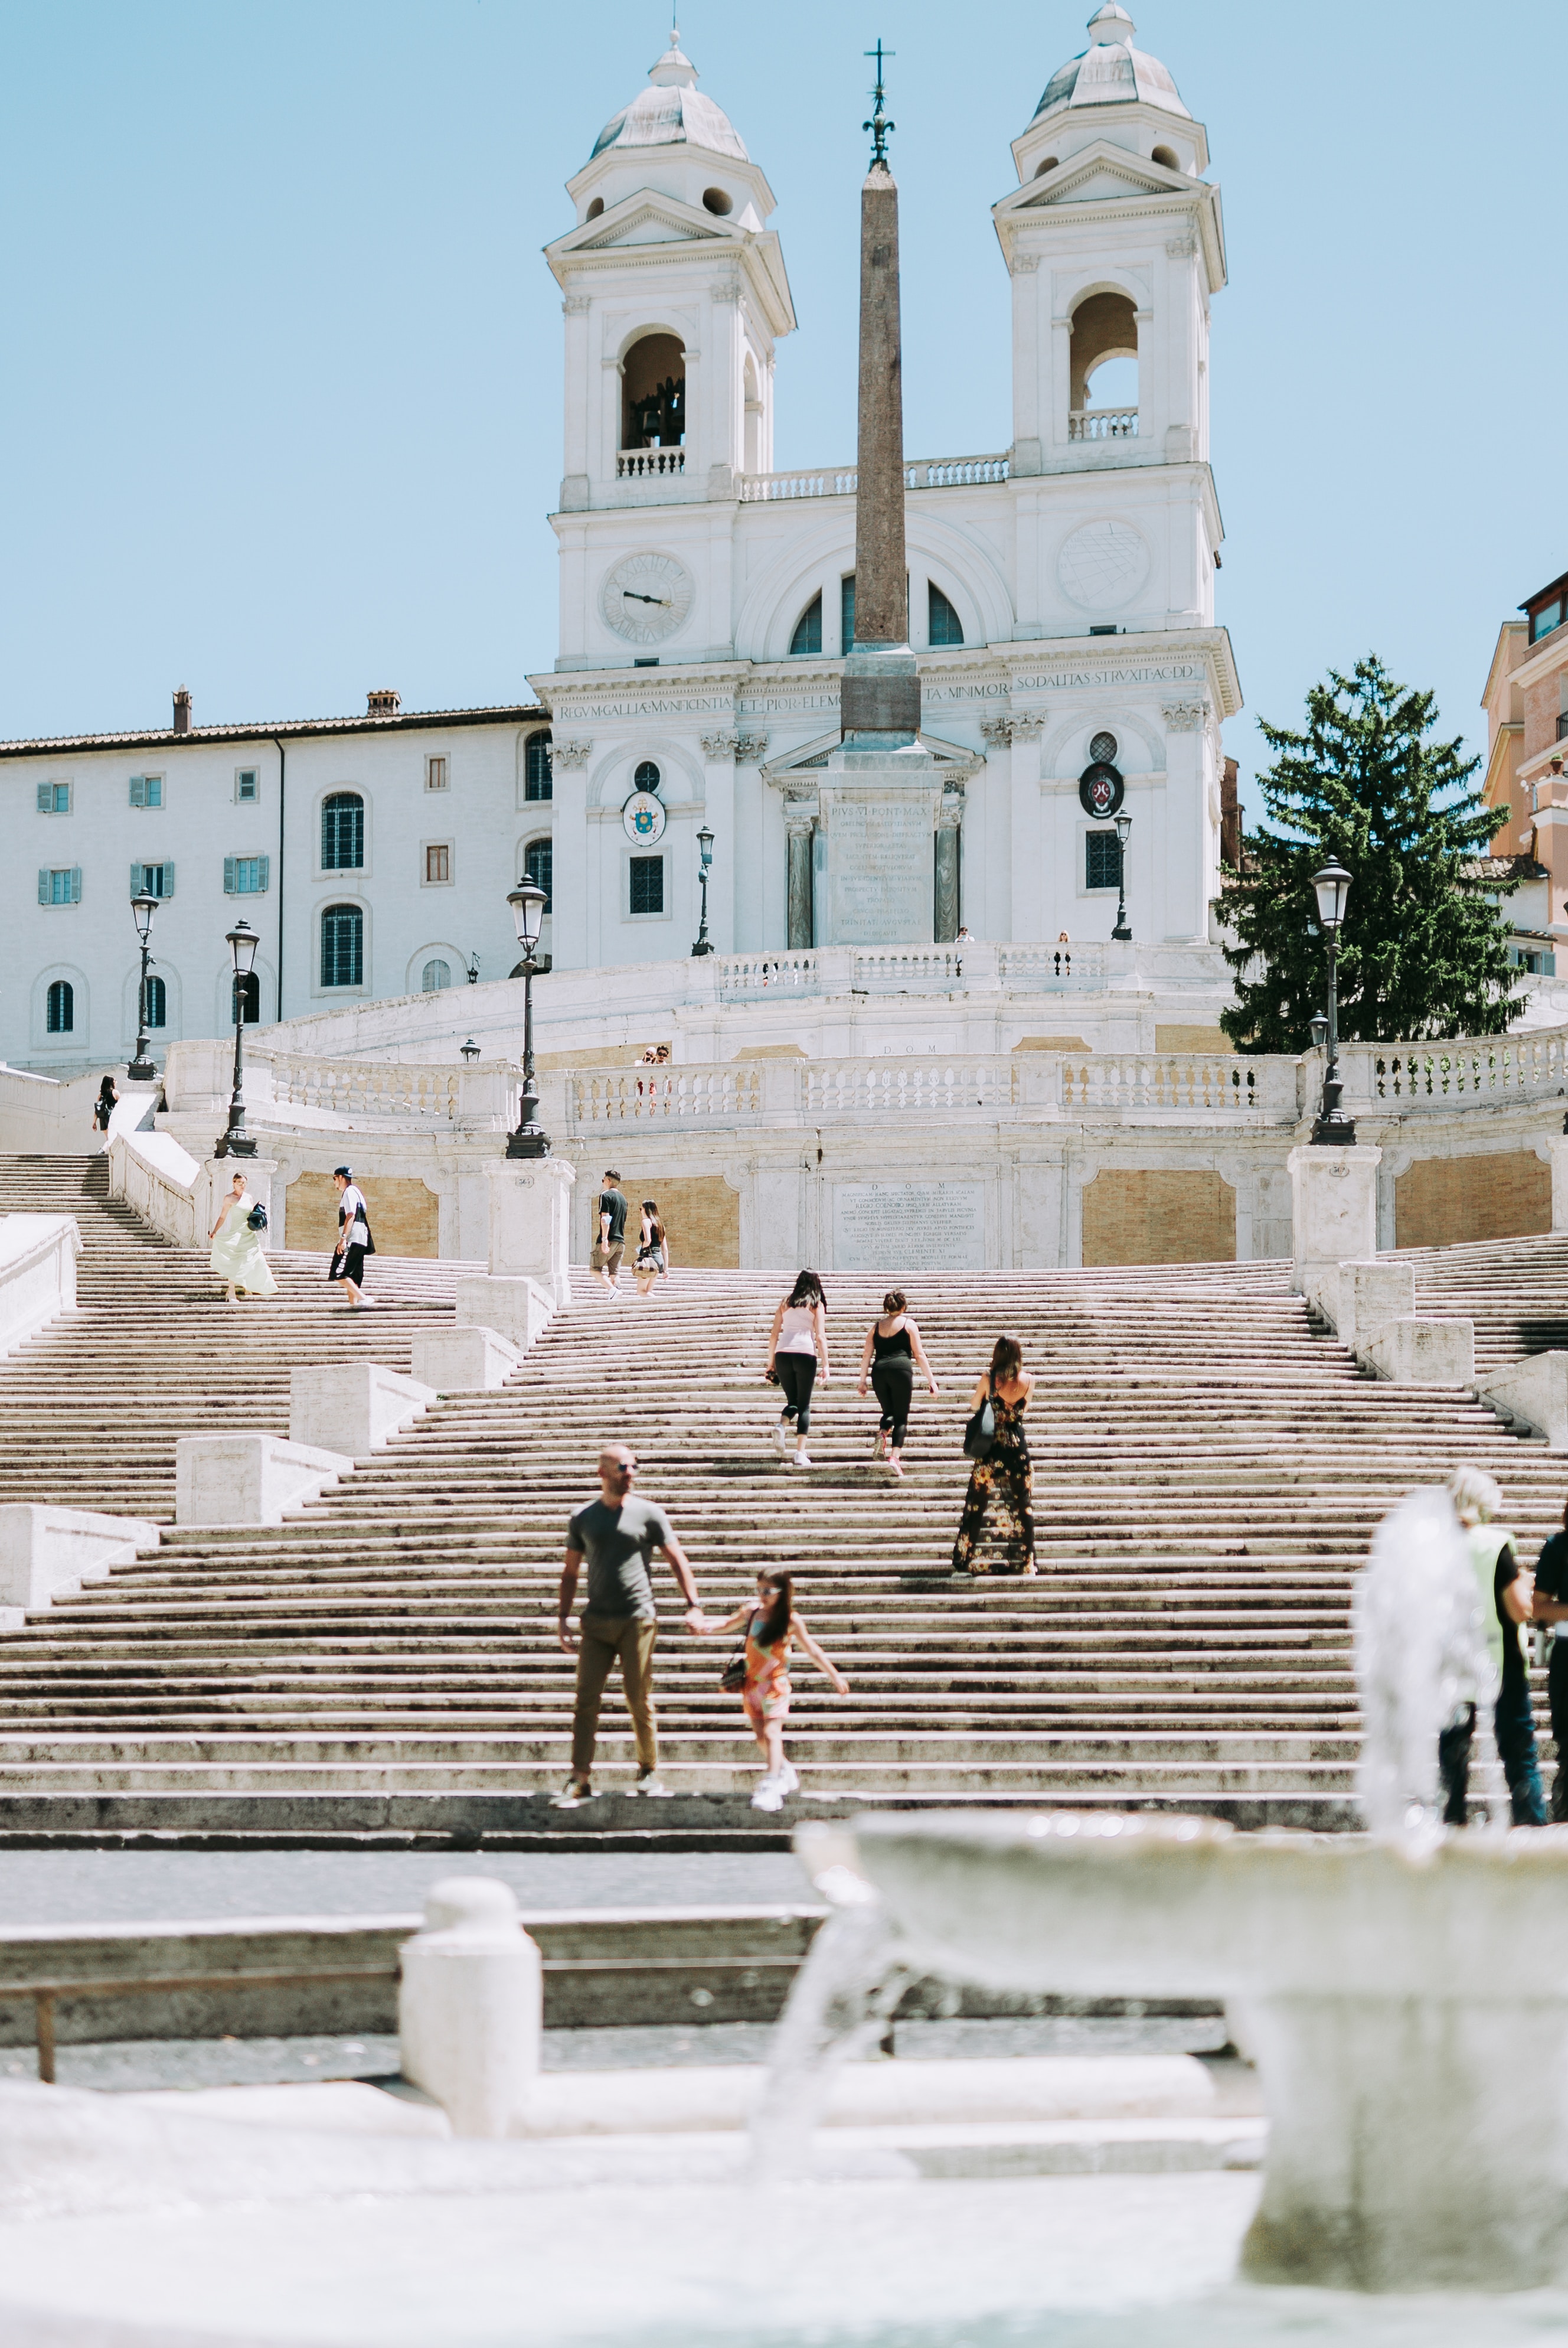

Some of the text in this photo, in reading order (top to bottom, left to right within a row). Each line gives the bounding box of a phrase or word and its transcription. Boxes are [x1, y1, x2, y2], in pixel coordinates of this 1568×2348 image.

[561, 705, 600, 719] REGVM
[740, 699, 759, 712] ET
[767, 698, 797, 710] PIOR
[949, 683, 1008, 698] MINIMOR
[1095, 668, 1152, 684] STRVXIT
[832, 807, 927, 816] PIVS VI PONT MAX
